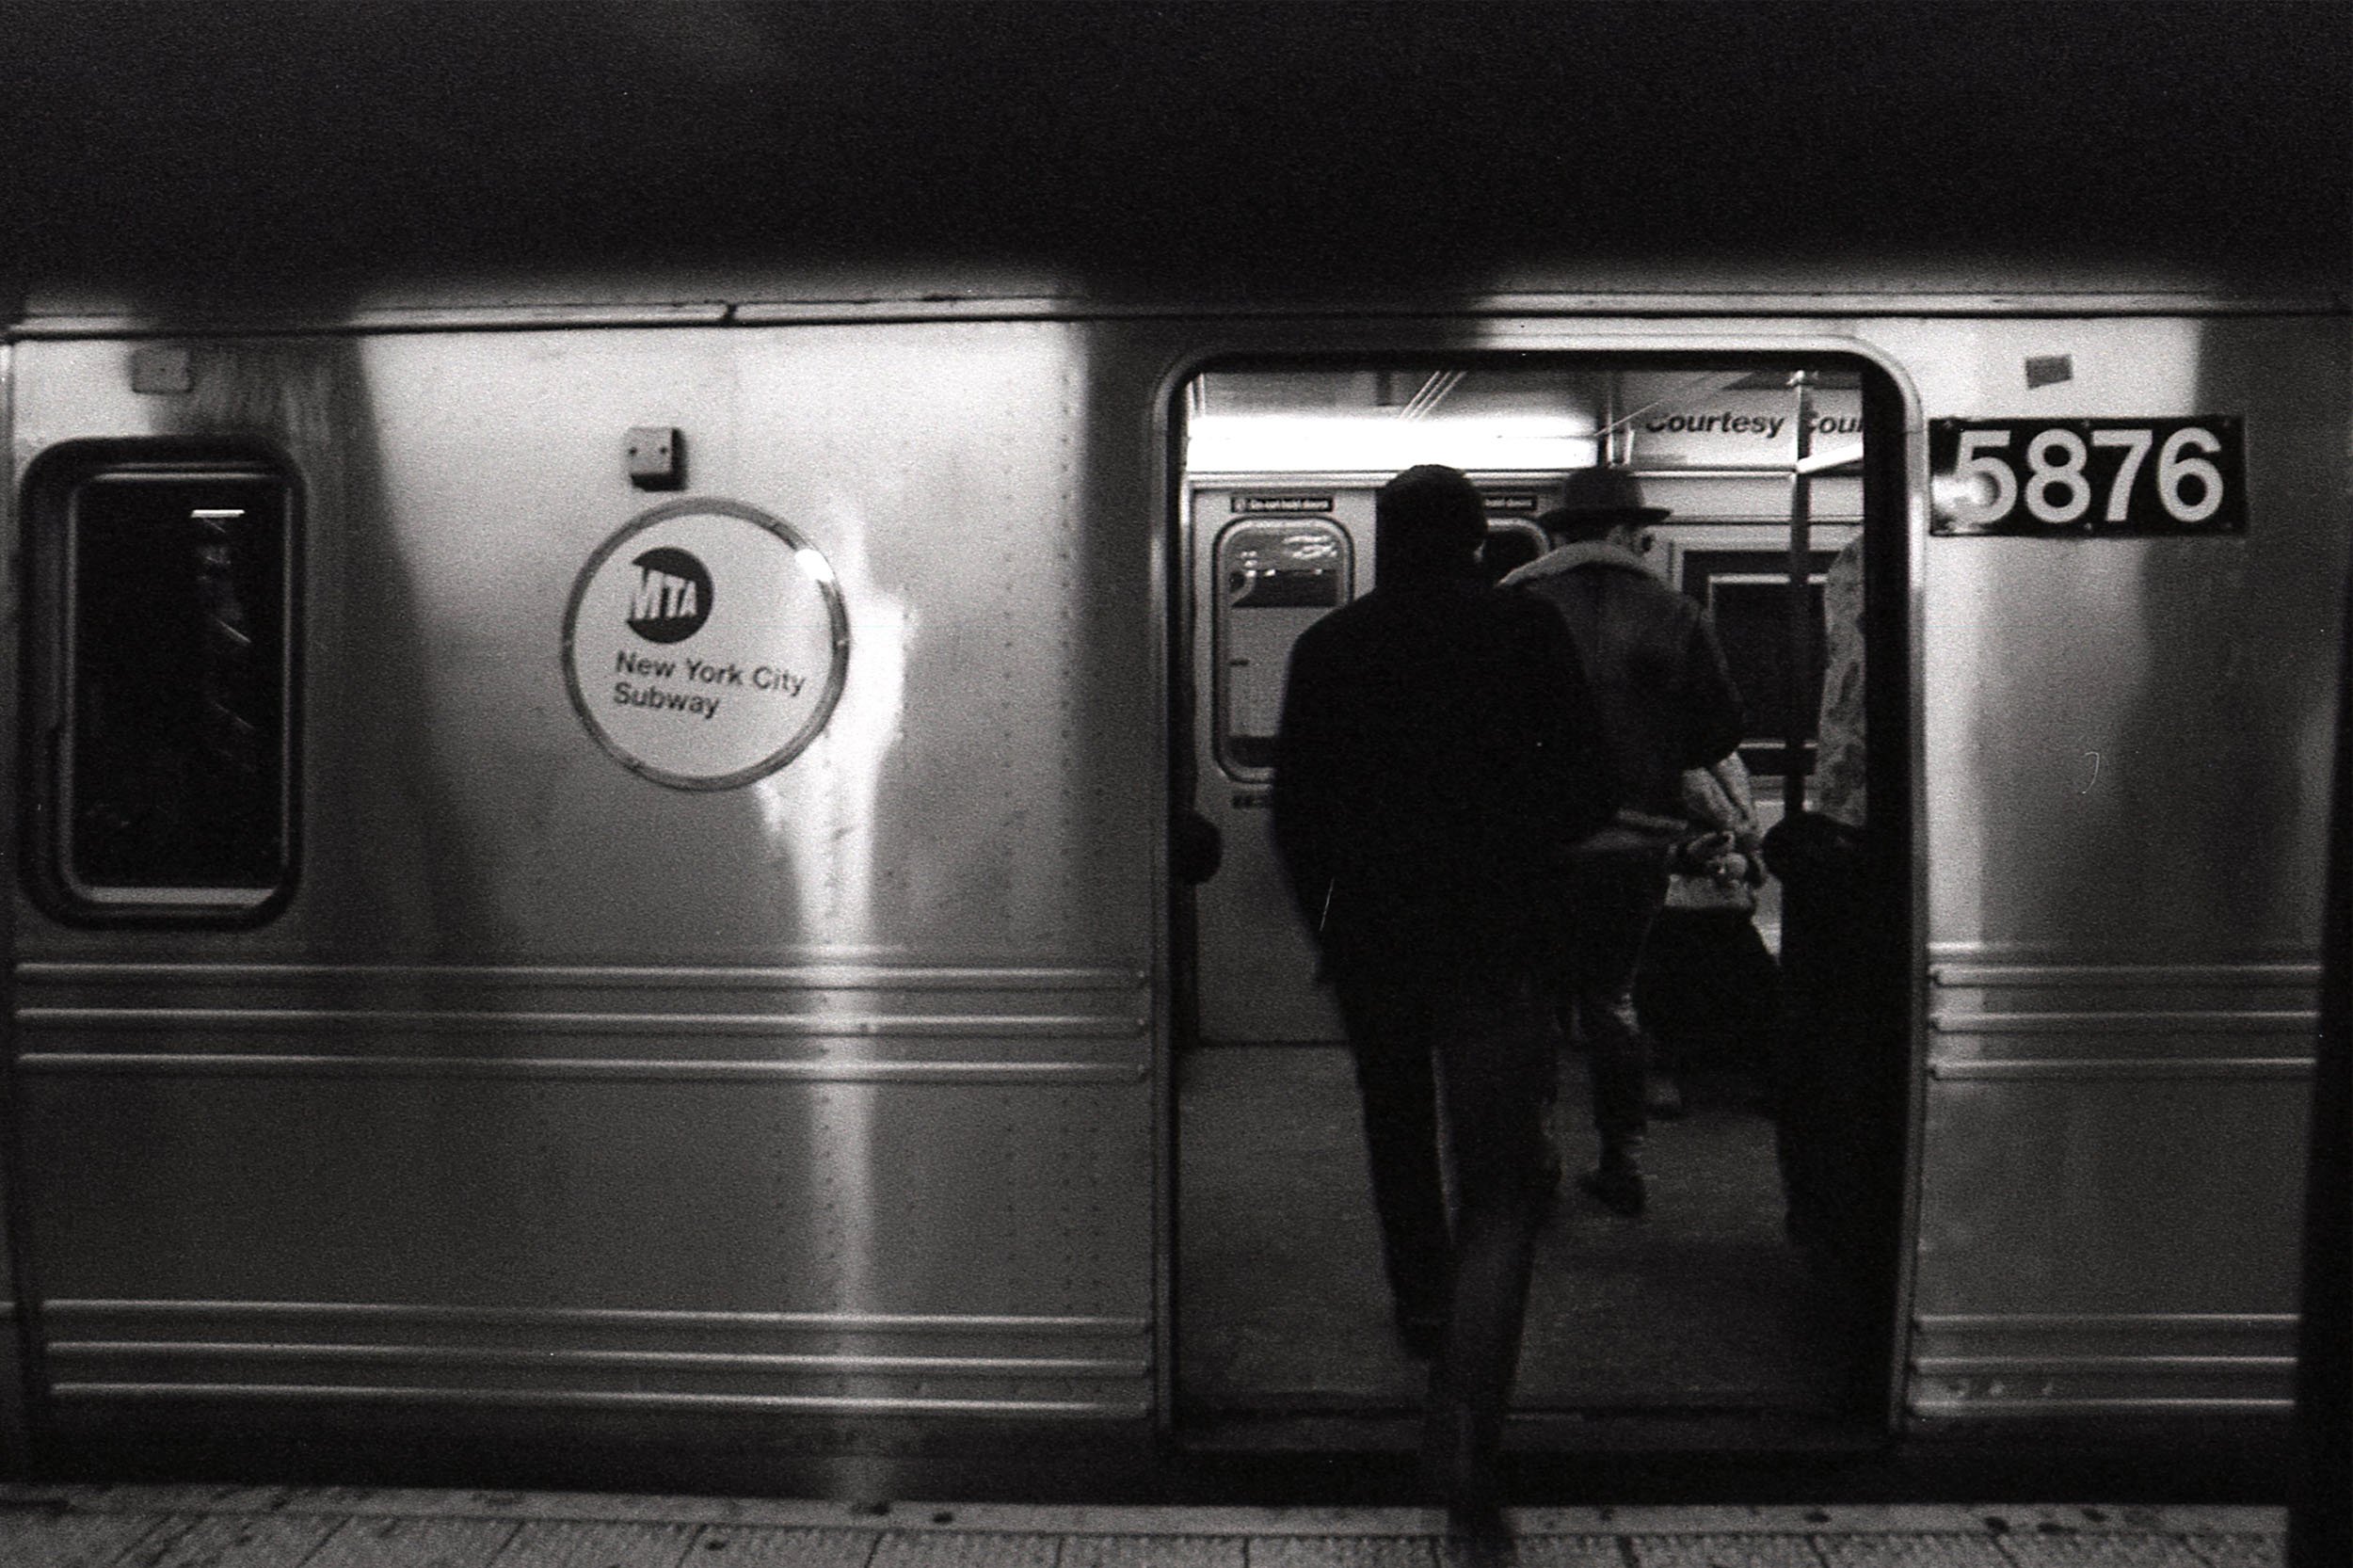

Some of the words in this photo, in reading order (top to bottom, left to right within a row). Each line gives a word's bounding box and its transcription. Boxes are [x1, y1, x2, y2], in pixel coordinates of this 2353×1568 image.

[1645, 411, 1785, 439] Courtesy
[1945, 427, 2224, 525] 5876
[627, 567, 698, 621] MTA
[615, 649, 676, 678] New
[685, 657, 744, 686] York
[752, 665, 806, 697] City
[614, 680, 720, 720] Subway
